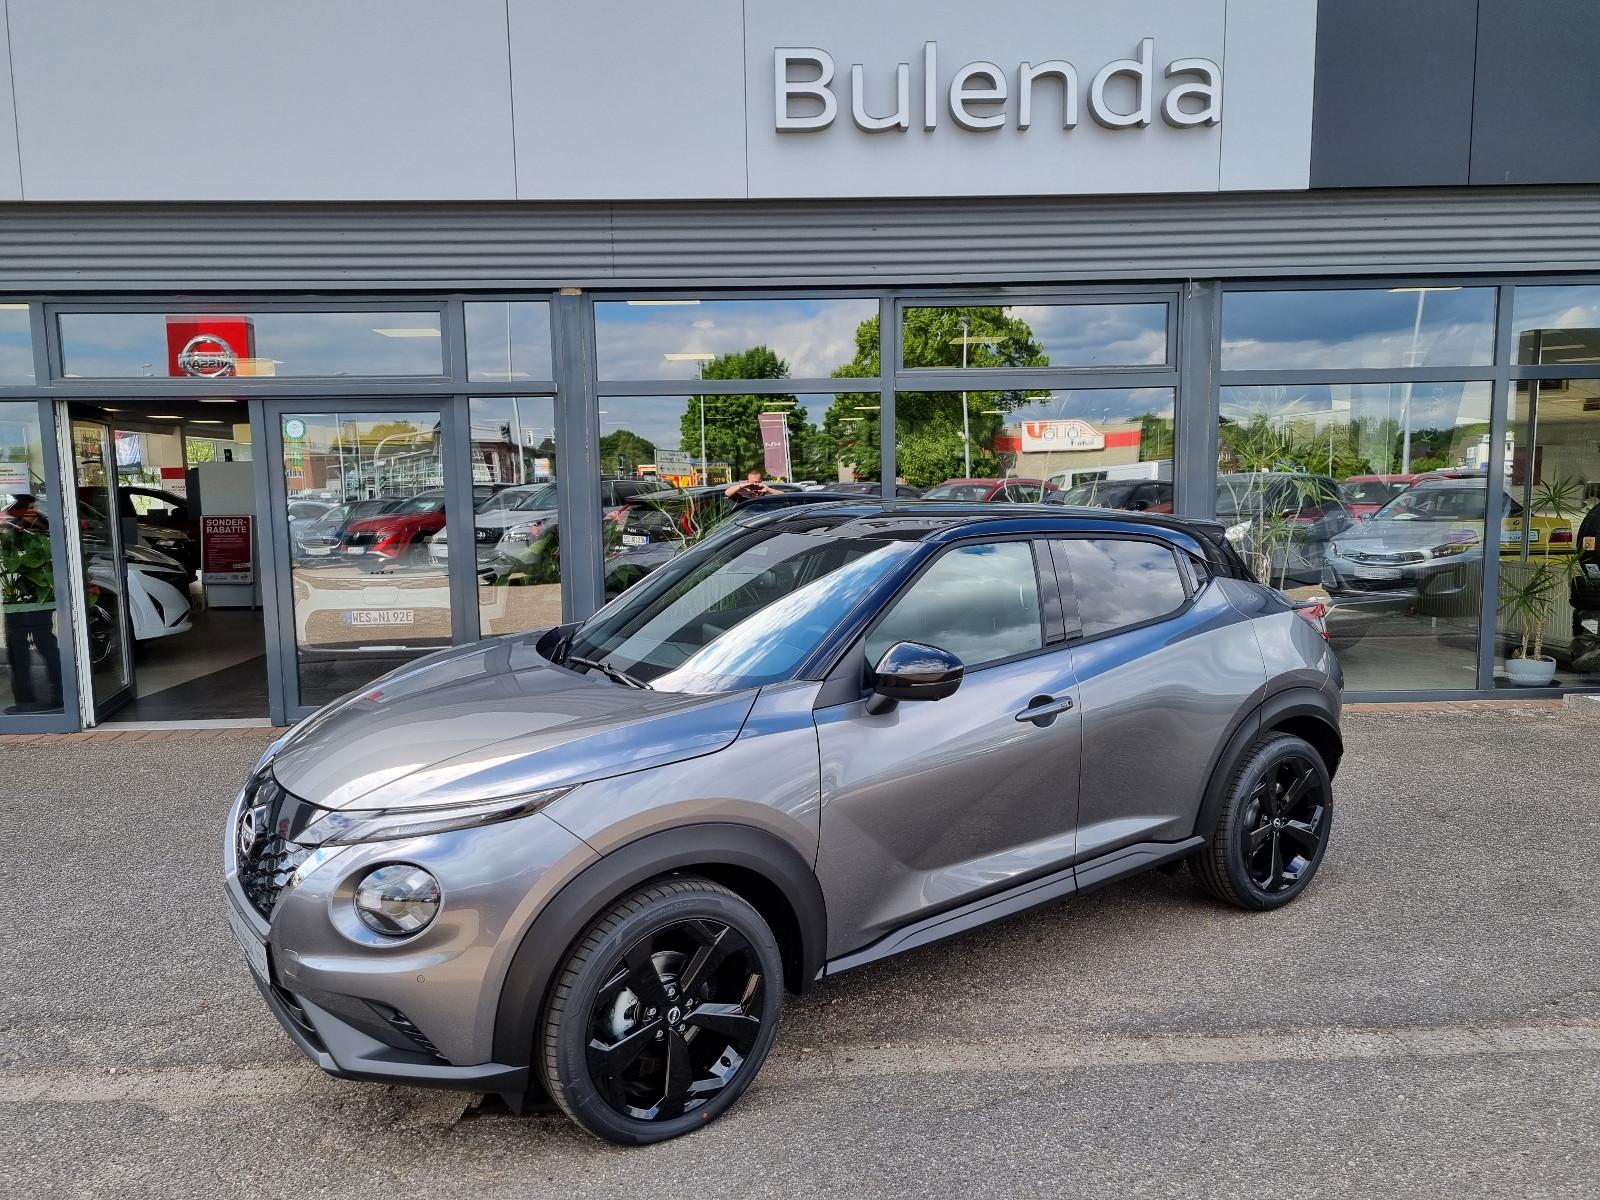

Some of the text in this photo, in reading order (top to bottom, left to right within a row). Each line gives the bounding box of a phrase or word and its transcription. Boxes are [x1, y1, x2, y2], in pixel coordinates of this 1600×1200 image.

[773, 37, 1222, 134] Bulenda
[206, 518, 247, 526] SONDER-
[206, 526, 247, 534] RABATTE
[352, 611, 413, 623] WES NI 92E
